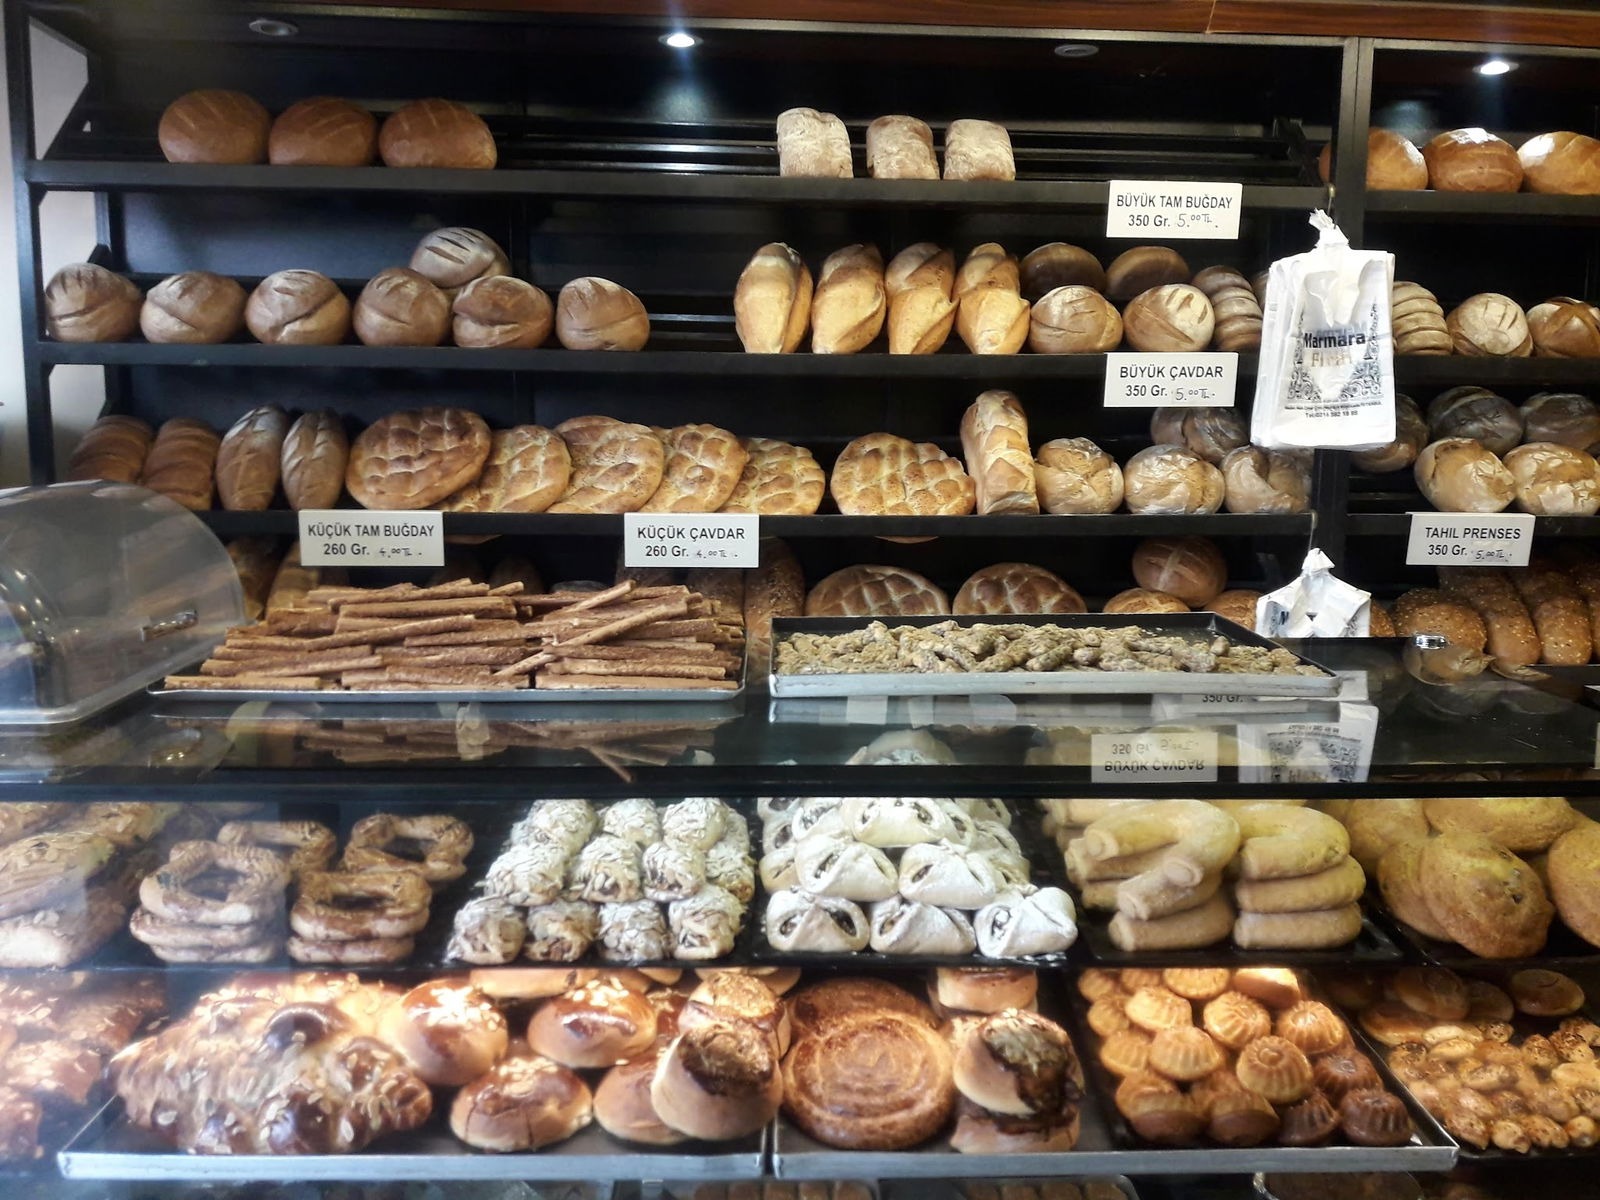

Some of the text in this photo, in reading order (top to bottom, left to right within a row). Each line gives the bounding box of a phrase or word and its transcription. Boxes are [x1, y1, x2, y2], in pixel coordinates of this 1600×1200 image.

[1116, 192, 1232, 208] BÜYÜK TAM BUĞDAY
[1128, 214, 1149, 227] 350
[1153, 214, 1171, 227] Gr.
[1304, 333, 1366, 348] Marmara
[1120, 363, 1223, 381] BÜYÜK ÇAVDAR
[1126, 384, 1147, 396] 350
[1150, 384, 1168, 397] Gr.
[307, 522, 434, 539] KÜÇÜK TAM BUĞDAY
[637, 525, 745, 542] KÜÇÜK ÇAVDAR
[1425, 527, 1521, 539] TAHIL PRENSES
[323, 543, 346, 555] 260
[350, 543, 370, 556] Gr.
[645, 545, 667, 557] 260
[671, 545, 689, 557] Gr.
[1427, 544, 1448, 556] 350
[1451, 544, 1468, 556] Gr.
